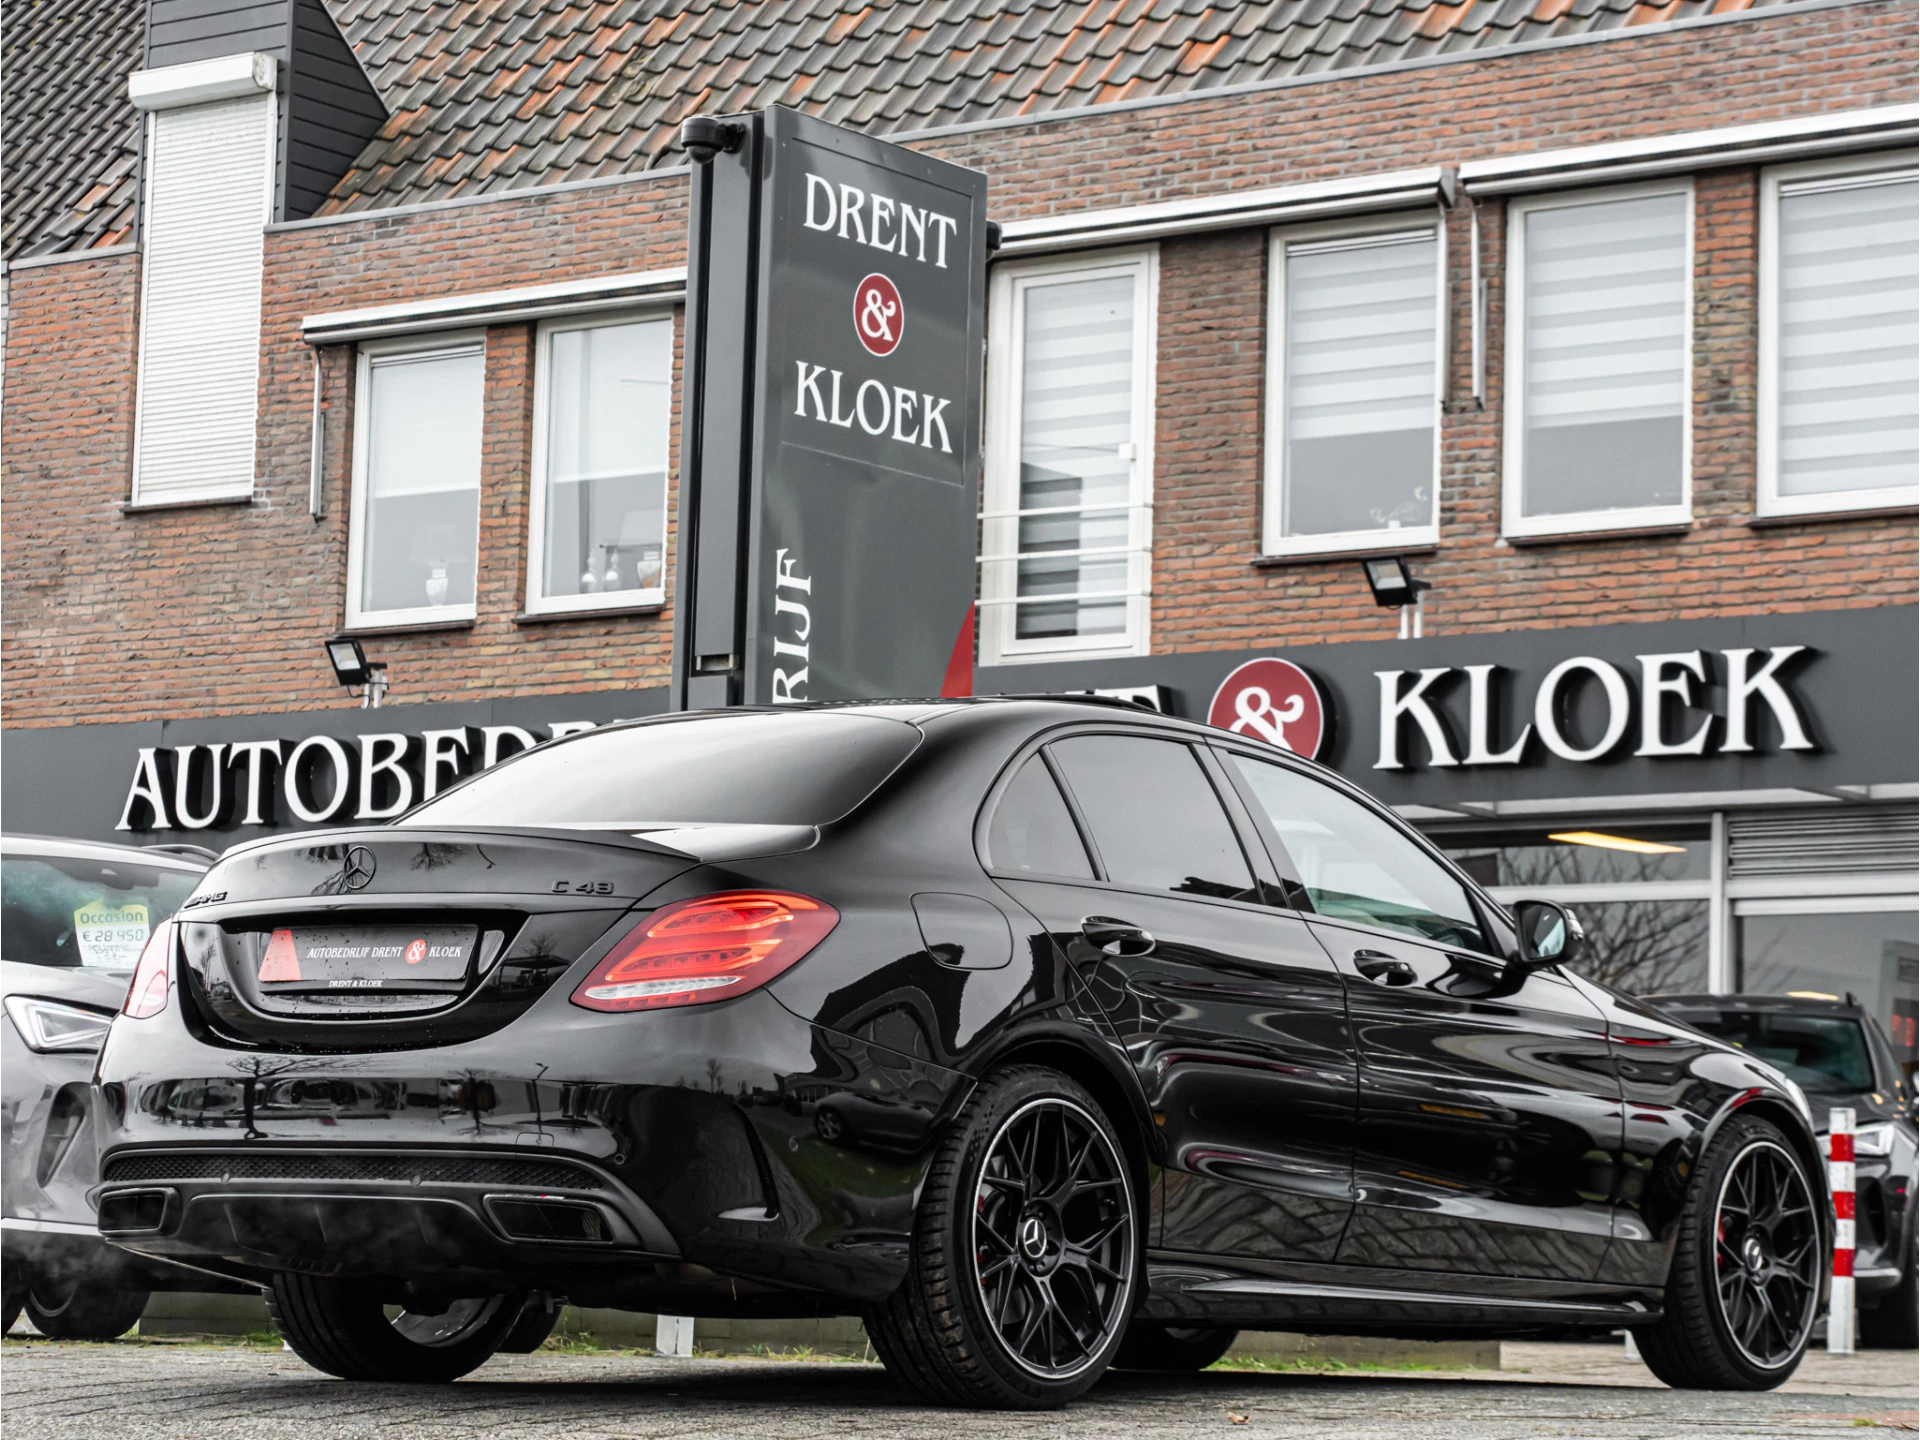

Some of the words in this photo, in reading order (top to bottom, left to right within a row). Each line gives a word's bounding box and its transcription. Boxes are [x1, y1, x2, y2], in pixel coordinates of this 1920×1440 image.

[803, 172, 958, 269] DRENT
[861, 288, 897, 342] &
[794, 360, 953, 454] KLOEK
[1372, 645, 1815, 770] KLOEK
[551, 880, 570, 893] C
[80, 910, 144, 924] Occasion
[307, 947, 370, 958] AUTOBEDRIJF
[371, 946, 403, 958] DRENT
[408, 941, 426, 961] &
[428, 946, 463, 957] KLOEK
[328, 980, 352, 988] DRENT
[351, 980, 359, 988] &
[358, 980, 383, 988] KLOEK
